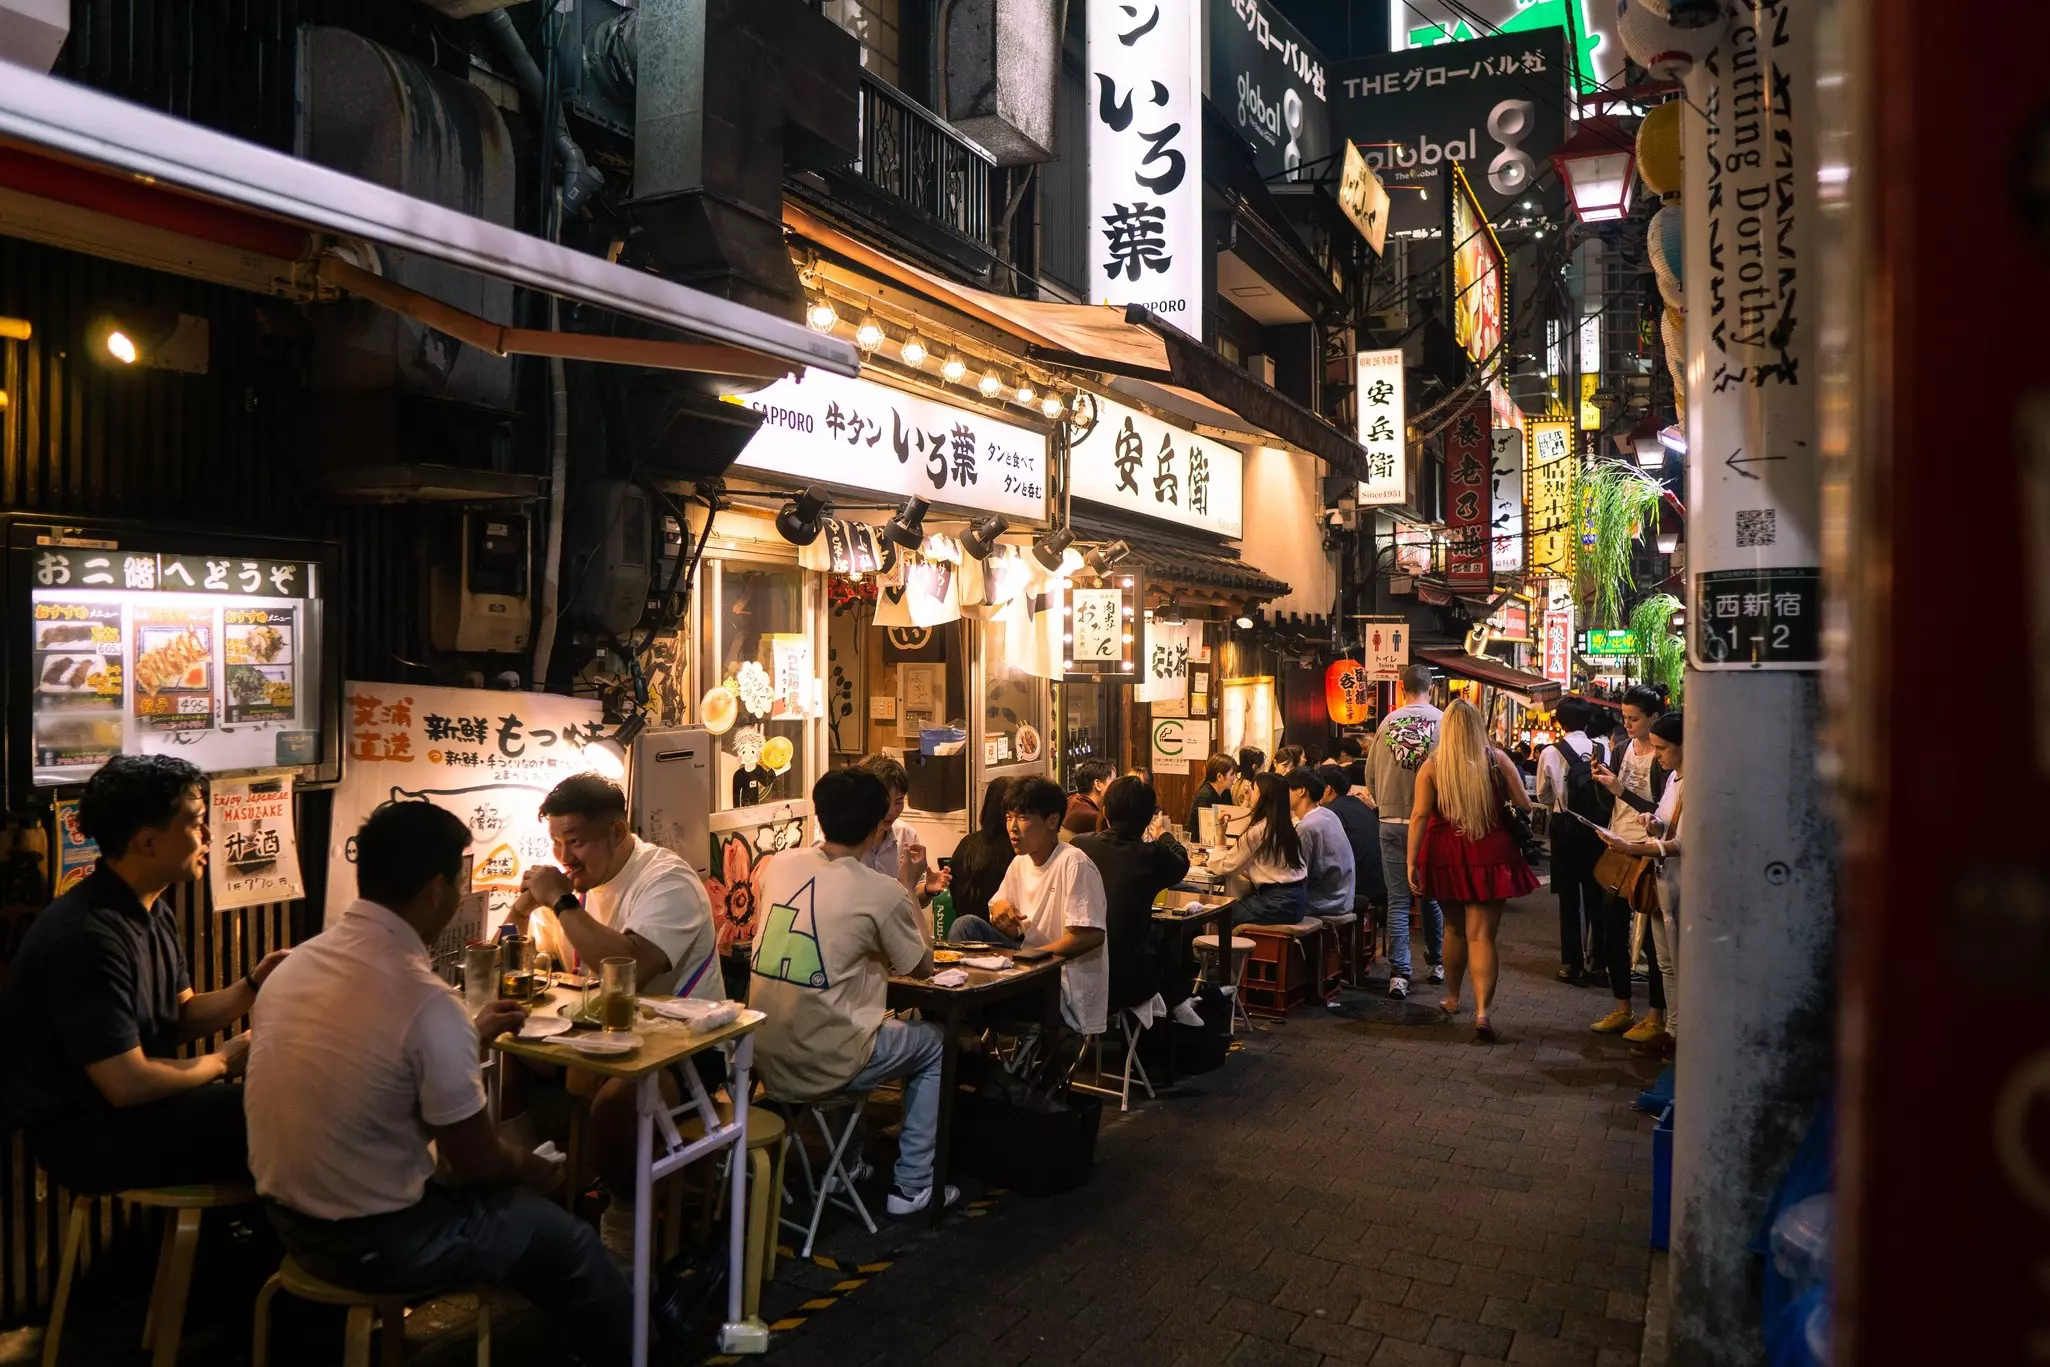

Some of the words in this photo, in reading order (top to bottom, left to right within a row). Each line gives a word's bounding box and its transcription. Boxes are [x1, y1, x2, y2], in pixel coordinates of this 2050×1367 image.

[1237, 71, 1281, 137] global
[1724, 25, 1764, 174] cutting
[1729, 186, 1779, 350] Dorothy
[1367, 379, 1395, 478] 安兵衛
[986, 441, 1035, 472] タンと食べて
[1114, 415, 1210, 517] 安兵衛
[1003, 474, 1042, 501] タンと呑む
[37, 552, 297, 595] お二階へどうぞ
[1715, 591, 1802, 618] 西新宿
[1375, 655, 1398, 663] トイレ
[350, 729, 415, 763] 直送
[213, 794, 242, 806] Enjoy
[247, 790, 289, 805] Japanese
[224, 829, 281, 860] 升酒
